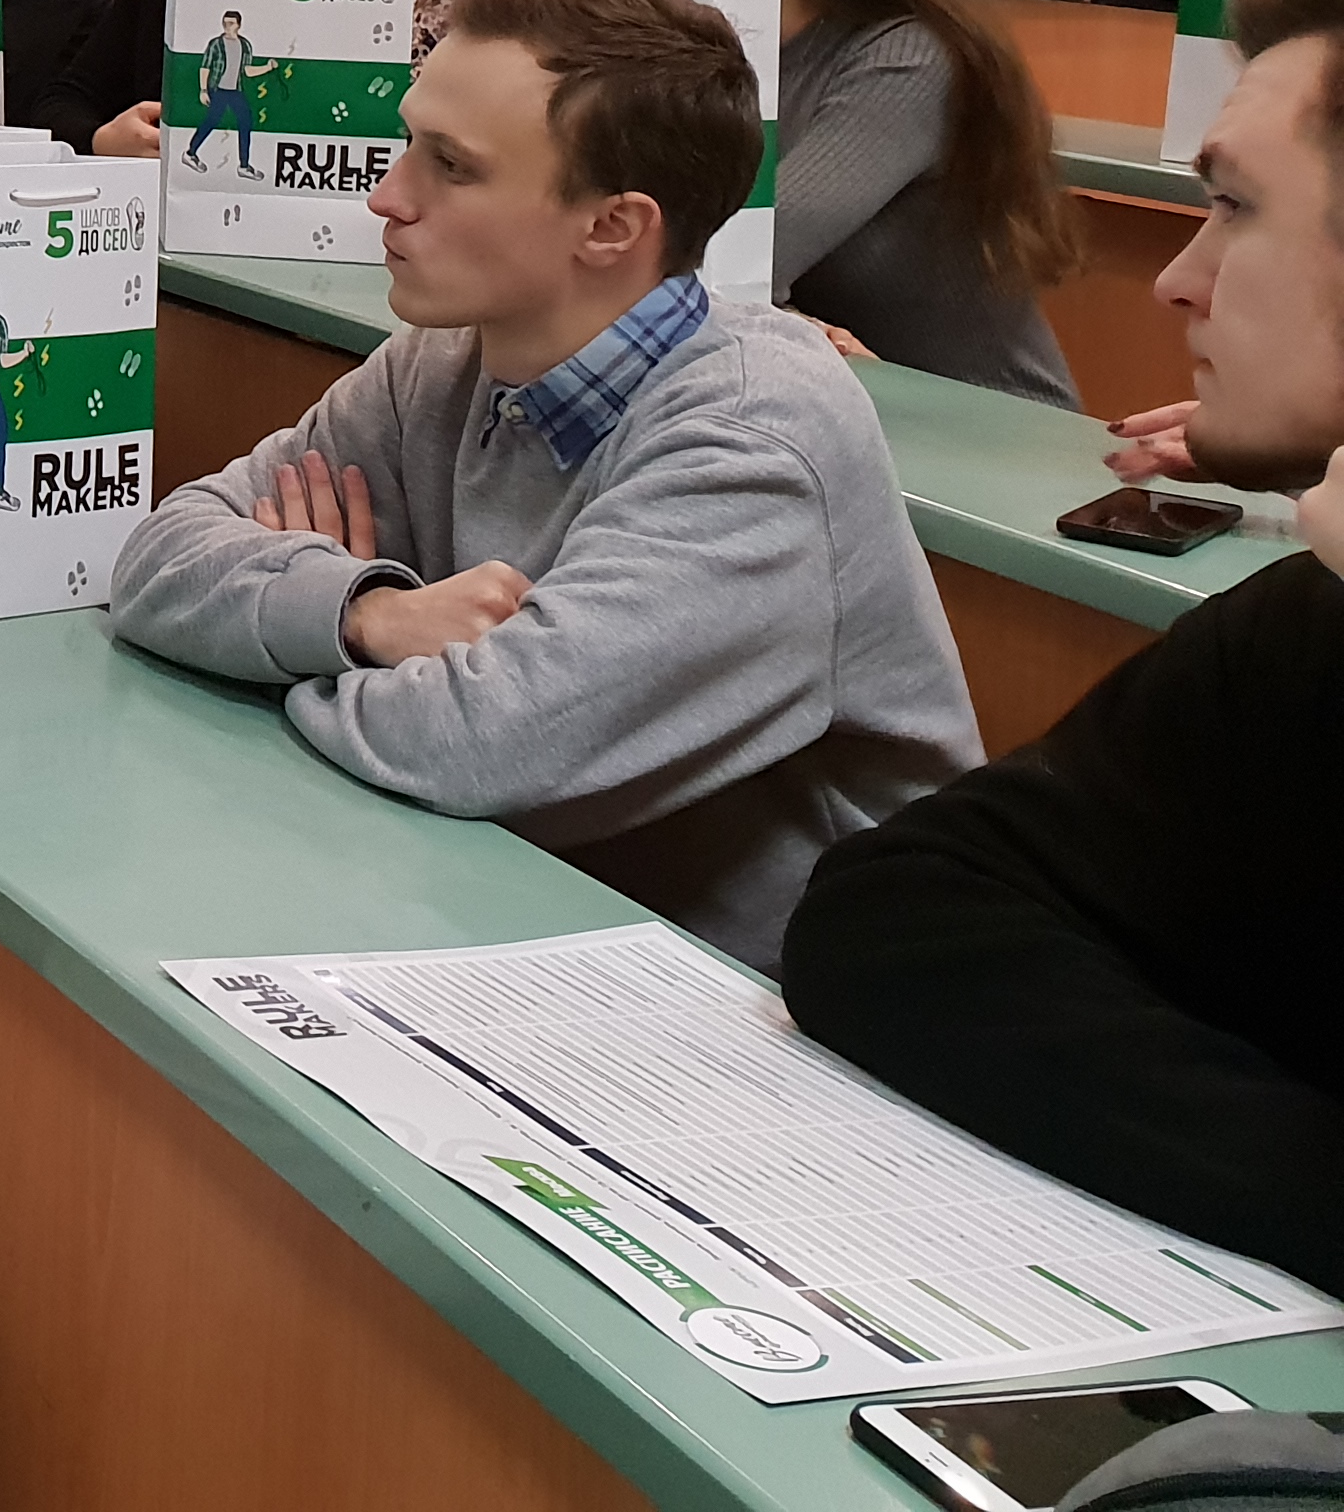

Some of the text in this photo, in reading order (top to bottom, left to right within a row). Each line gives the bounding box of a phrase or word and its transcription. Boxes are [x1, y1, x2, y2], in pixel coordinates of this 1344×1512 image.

[277, 142, 391, 175] RULE
[45, 208, 120, 258] 5 ШАГОВ
[78, 230, 98, 256] ДО
[34, 443, 139, 491] RULE
[32, 483, 139, 518] MAKERS
[212, 974, 324, 1040] RULE
[244, 974, 348, 1038] MAKERS
[558, 1205, 692, 1290] РАСПИСАНИЕ
